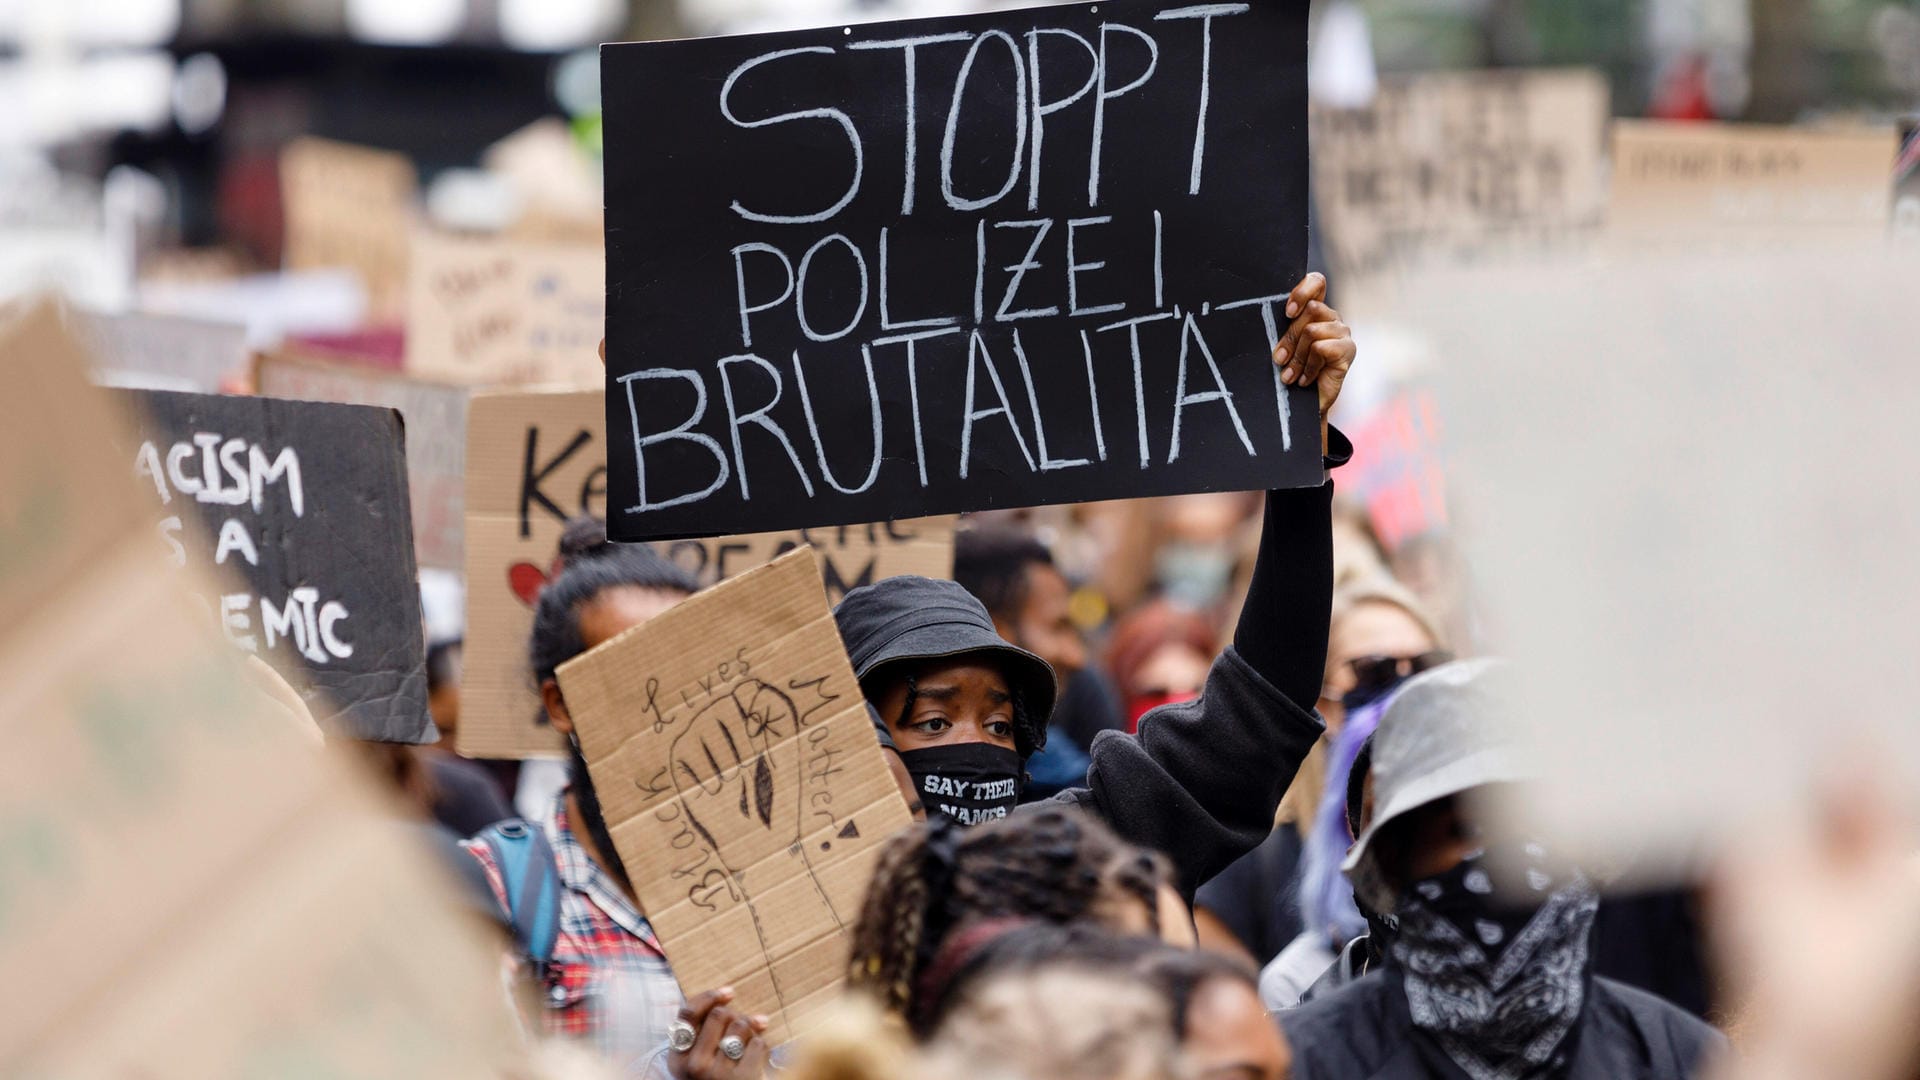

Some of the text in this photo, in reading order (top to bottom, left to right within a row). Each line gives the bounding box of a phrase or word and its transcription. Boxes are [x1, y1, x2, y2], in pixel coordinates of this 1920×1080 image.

[720, 3, 1250, 225] STOPPT
[731, 210, 1164, 348] POLIZEI
[617, 294, 1293, 514] BRUTALITÄT
[134, 432, 304, 519] ACISM
[520, 426, 606, 540] Ke
[158, 516, 260, 568] S A
[219, 586, 354, 664] EMIC
[641, 646, 751, 735] Lives
[924, 774, 1015, 800] SAY THEIR
[634, 766, 741, 912] Black
